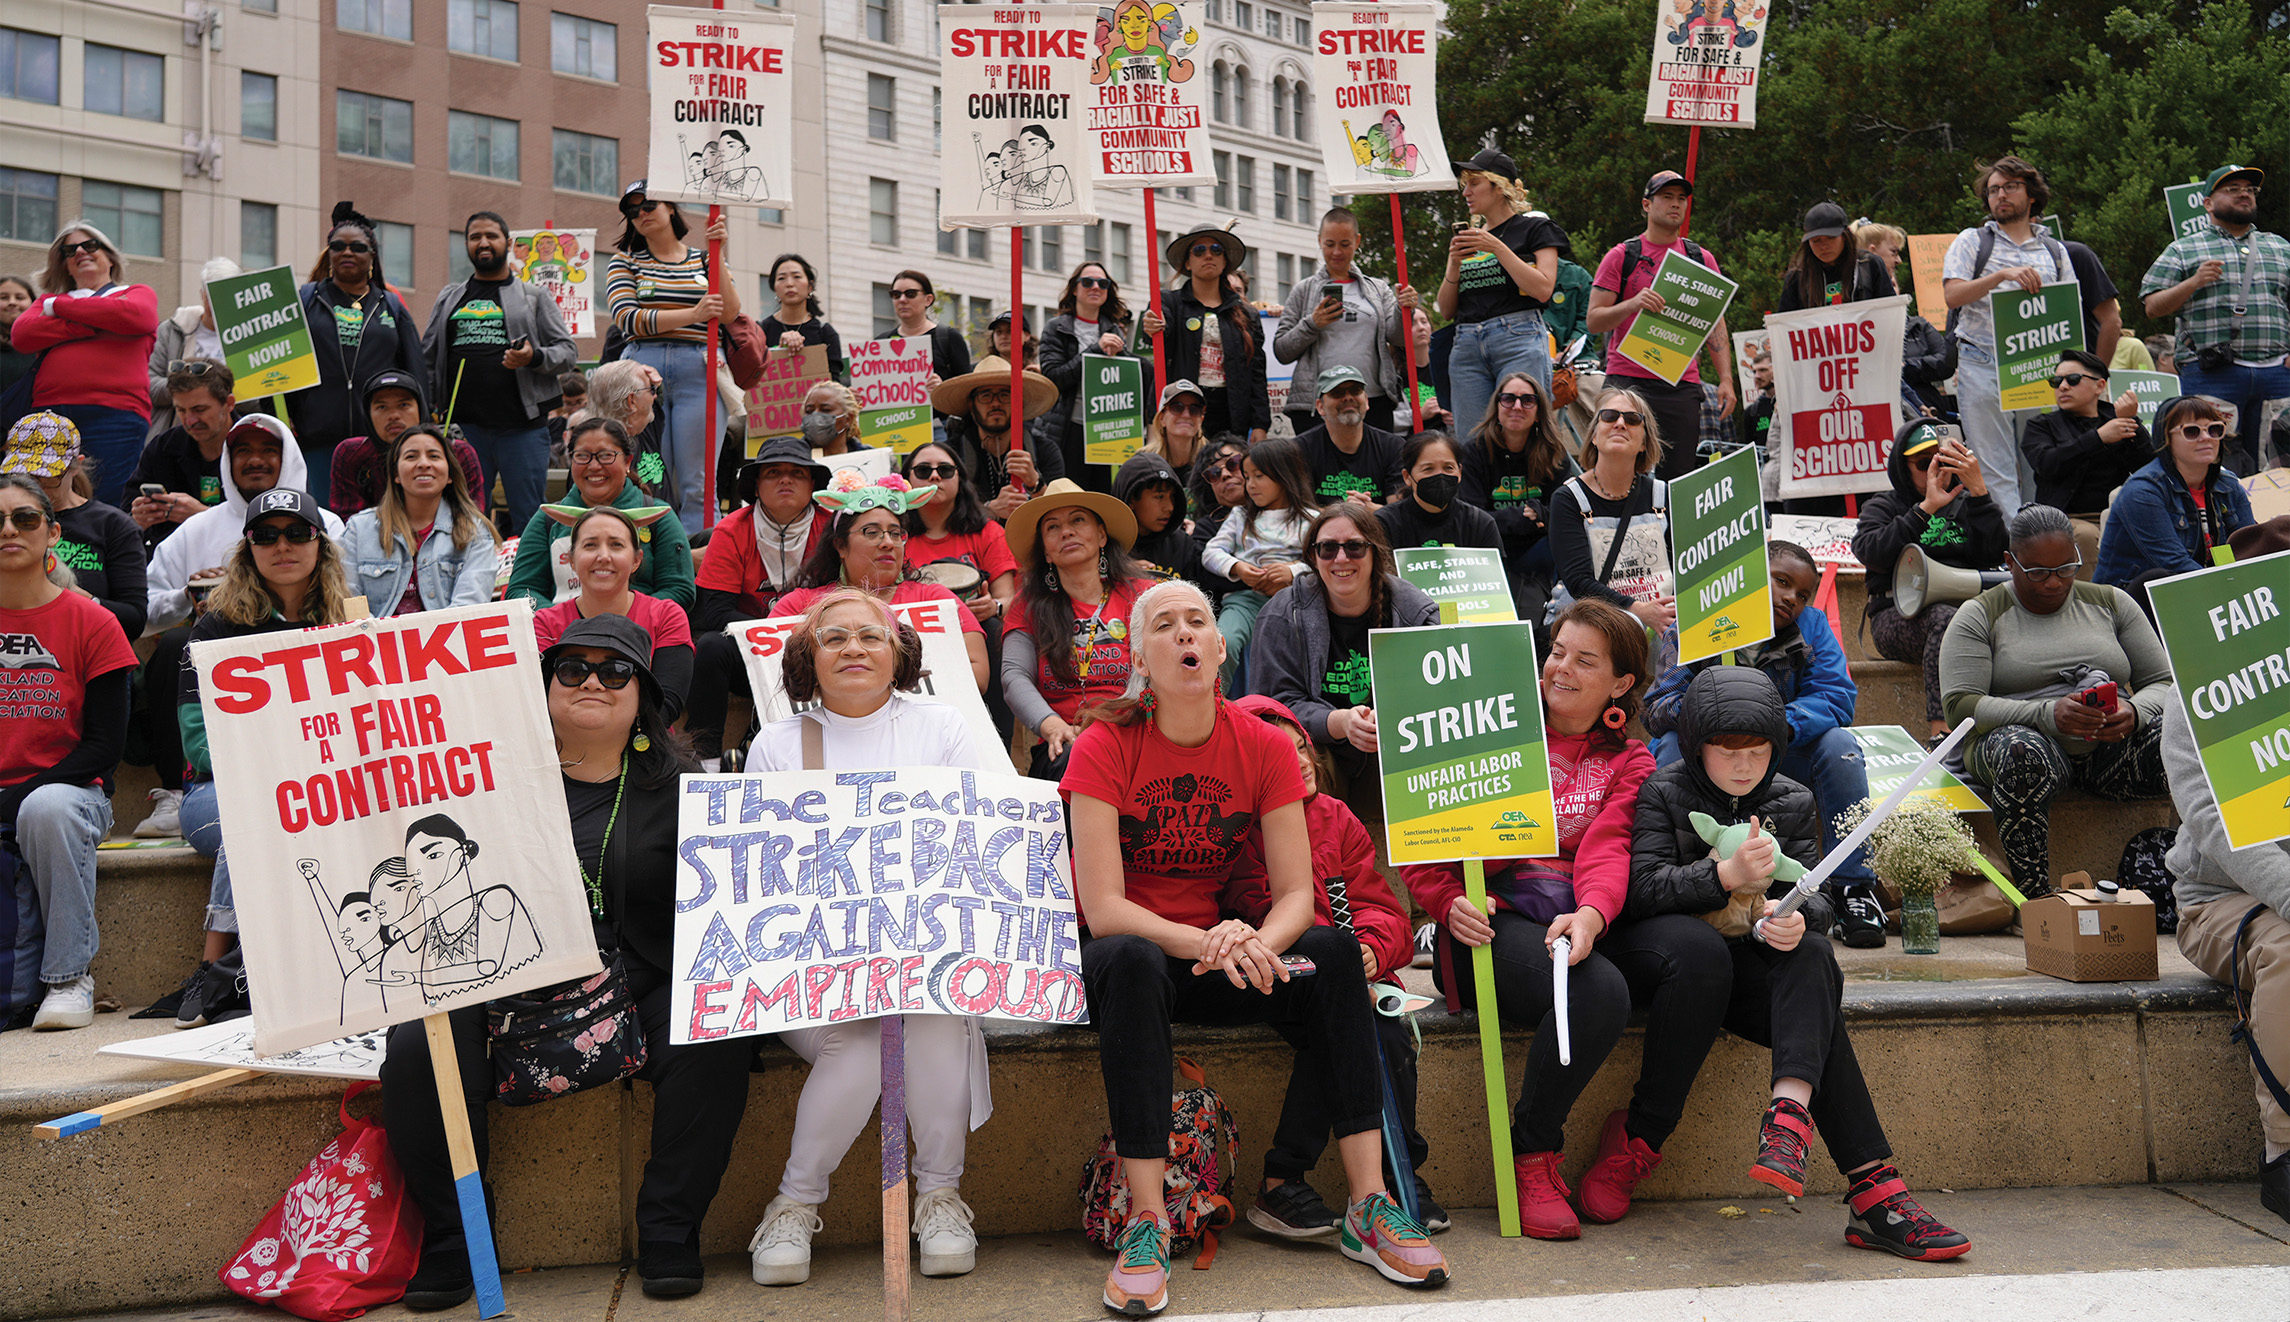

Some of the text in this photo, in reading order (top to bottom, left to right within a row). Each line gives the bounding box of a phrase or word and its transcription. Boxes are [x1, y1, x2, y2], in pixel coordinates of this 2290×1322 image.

[993, 10, 1041, 23] READY TO
[1353, 12, 1389, 24] READY TO
[696, 25, 739, 39] READY TO
[951, 28, 1087, 60] STRIKE
[1318, 29, 1425, 55] STRIKE
[1698, 33, 1725, 45] STRIKE
[657, 41, 783, 74] STRIKE
[1676, 46, 1741, 65] FOR SAFE &
[985, 64, 1050, 90] FOR FAIR
[1123, 65, 1157, 81] STRIKE
[1366, 58, 1397, 81] FAIR
[1660, 63, 1754, 84] RACIALLY JUST
[689, 73, 747, 100] FOR FAIR
[694, 86, 700, 96] A
[990, 78, 996, 89] A
[1099, 84, 1180, 105] FOR SAFE &
[1336, 82, 1411, 109] CONTRACT
[1669, 83, 1739, 101] COMMUNITY
[675, 99, 764, 127] CONTRACT
[968, 93, 1070, 119] CONTRACT
[1088, 105, 1197, 128] RACIALLY JUST
[1672, 101, 1733, 121] SCHOOLS
[1101, 129, 1186, 149] COMMUNITY
[1109, 151, 1185, 174] SCHOOLS
[234, 281, 274, 309] FAIR
[569, 286, 575, 296] &
[1664, 271, 1690, 289] SAFE,
[1690, 280, 1725, 300] STABLE
[559, 299, 586, 310] JUST
[1677, 292, 1699, 307] AND
[2019, 295, 2047, 320] ON
[222, 302, 299, 345] CONTRACT
[1660, 305, 1711, 331] CIALLY JUST
[1647, 325, 1687, 346] SCHOOLS
[1788, 320, 1875, 361] HANDS
[2005, 320, 2071, 356] STRIKE
[248, 339, 293, 369] NOW!
[850, 349, 934, 379] community
[2010, 352, 2061, 376] UNFAIR LAB
[1100, 366, 1120, 385] ON
[1818, 357, 1859, 392] OFF
[2129, 380, 2162, 394] FAIR
[1090, 392, 1135, 414] STRIKE
[875, 409, 917, 428] SCHOOLS
[1819, 409, 1864, 442] OUR
[1793, 439, 1896, 479] SCHOOLS
[1695, 475, 1734, 519] FAIR
[1677, 505, 1759, 575] CONTRACT
[1407, 557, 1490, 572] SAFE, STABLE
[1439, 570, 1466, 581] AND
[1626, 567, 1644, 578] SAFE
[1420, 581, 1501, 596] ACIALLY JUST
[1699, 565, 1745, 612] NOW!
[1457, 600, 1490, 611] OOLS
[2207, 586, 2280, 642] FAIR
[1714, 615, 1732, 628] OEA
[211, 614, 517, 715] STRIKE
[1422, 643, 1472, 685] ON
[301, 694, 447, 757] FOR FAIR
[1397, 693, 1518, 753] STRIKE
[320, 739, 335, 764] A
[1407, 751, 1523, 793] UNFAIR LABOR
[275, 741, 496, 834] CONTRACT
[687, 771, 1063, 826] The Teachers
[1427, 774, 1512, 810] PRACTICES
[1568, 794, 1586, 804] THE
[1161, 804, 1208, 829] PAZ
[1501, 811, 1529, 822] OEA
[1177, 829, 1190, 848] Y
[1403, 828, 1433, 837] Sanctioned
[1433, 828, 1440, 836] by
[1450, 825, 1474, 833] Alameda
[1404, 836, 1462, 847] Labor Council, AFL-CIO
[1518, 832, 1533, 841] nea
[911, 817, 1073, 904] BACK
[1142, 848, 1215, 865] AMOR
[687, 892, 1081, 981] AGAINST THE
[688, 955, 924, 1041] EMPIRE
